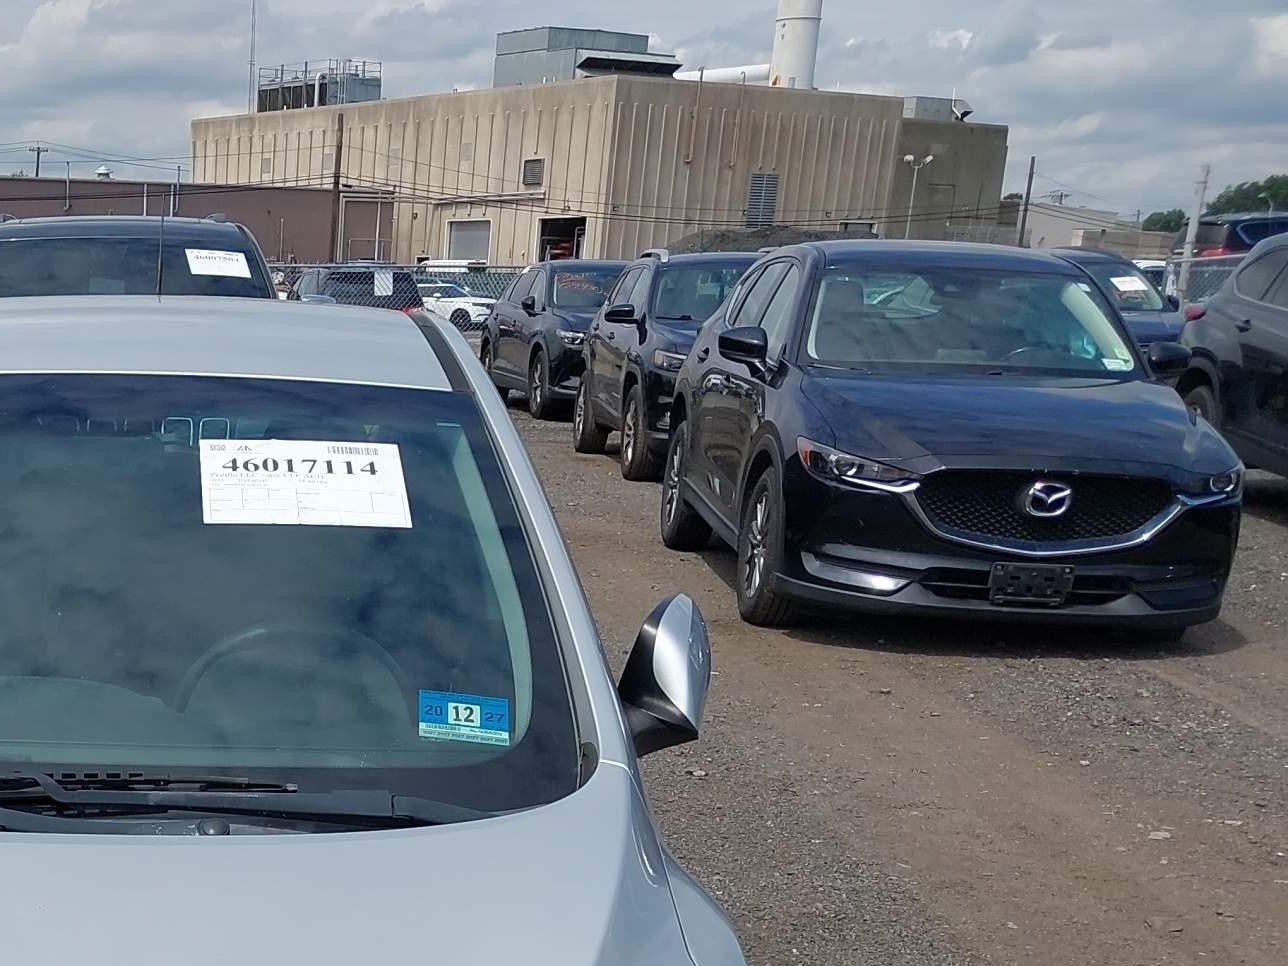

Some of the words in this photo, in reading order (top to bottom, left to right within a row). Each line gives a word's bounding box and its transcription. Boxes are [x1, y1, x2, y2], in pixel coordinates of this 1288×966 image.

[222, 457, 378, 476] 46017114
[424, 704, 443, 716] 20
[452, 705, 475, 723] 12
[484, 711, 505, 724] 27
